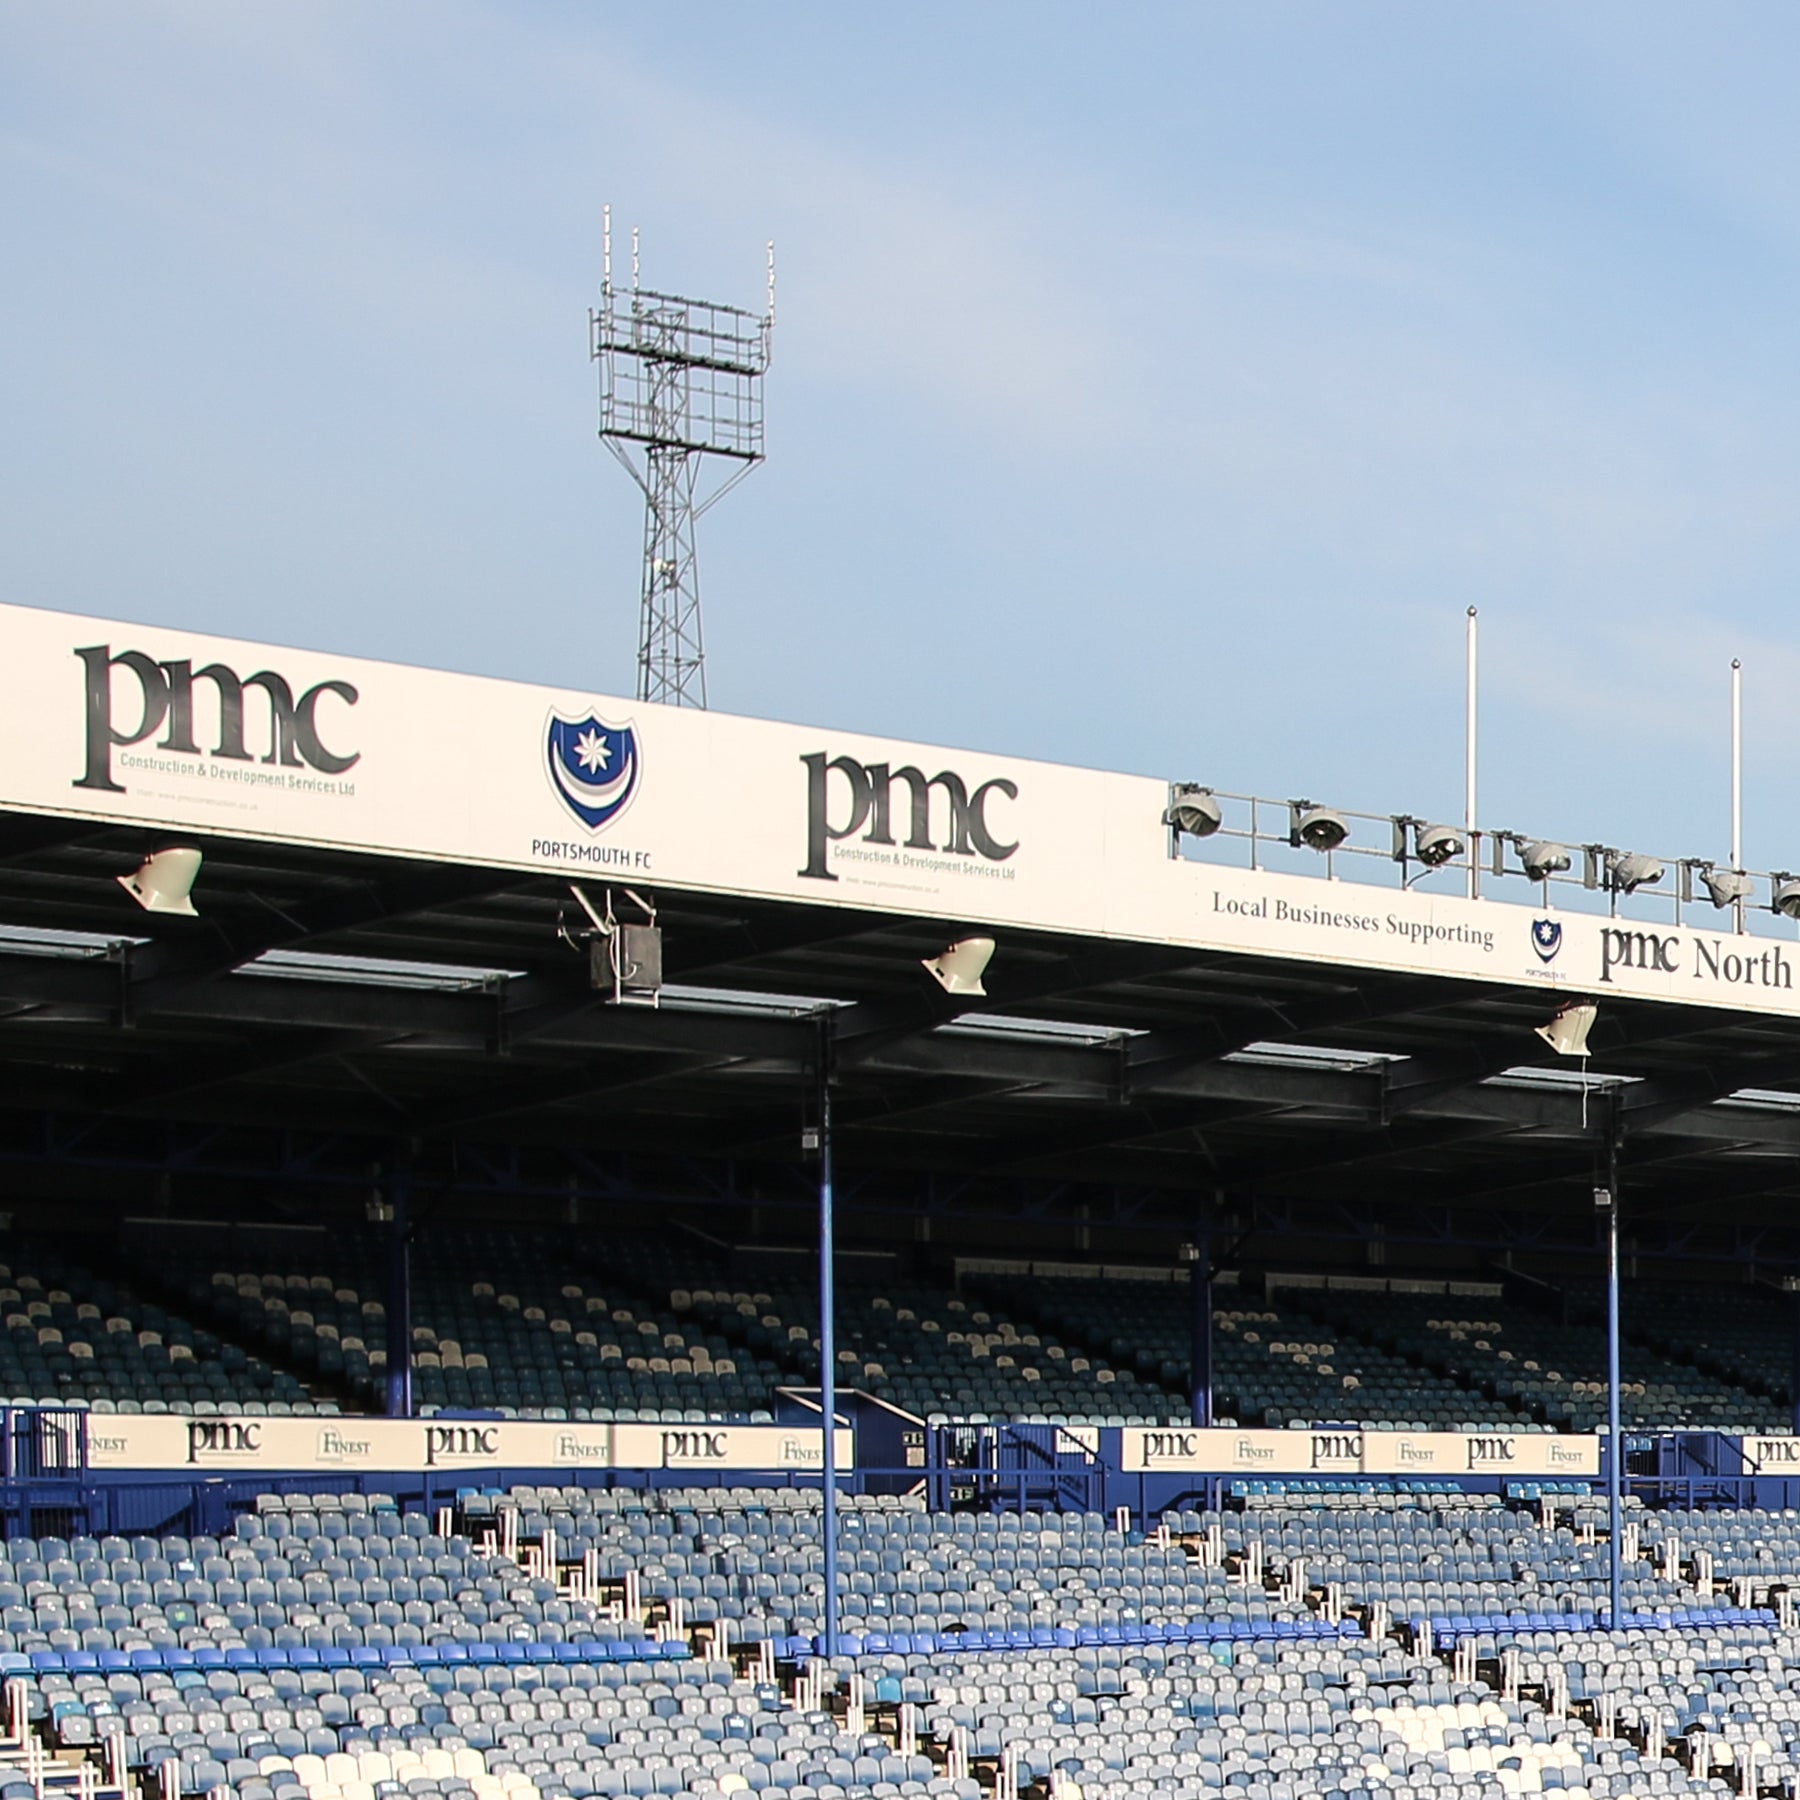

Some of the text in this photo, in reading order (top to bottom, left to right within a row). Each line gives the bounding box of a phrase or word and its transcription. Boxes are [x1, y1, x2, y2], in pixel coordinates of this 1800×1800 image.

[73, 644, 361, 793] pmc
[121, 753, 355, 795] Construction & Development Services Ltd
[797, 751, 1019, 881] pmc
[532, 838, 651, 870] PORTSMOUTH FC
[834, 845, 1000, 878] Construction Development Services
[1212, 890, 1494, 952] Local Businesses Supporting
[1599, 926, 1680, 981] pmc
[1693, 937, 1793, 989] North
[186, 1420, 261, 1464] pmc
[323, 1431, 370, 1454] FINEST
[424, 1426, 498, 1466] pmc
[560, 1437, 608, 1458] FINEST
[661, 1430, 728, 1467] pmc
[1141, 1431, 1197, 1467] pmc
[1237, 1440, 1275, 1459] FINEST
[1309, 1434, 1362, 1468] pmc
[1400, 1441, 1434, 1462] FINEST
[1466, 1436, 1516, 1469] pmc
[1550, 1443, 1583, 1464] FINEST
[1756, 1440, 1800, 1472] pmc
